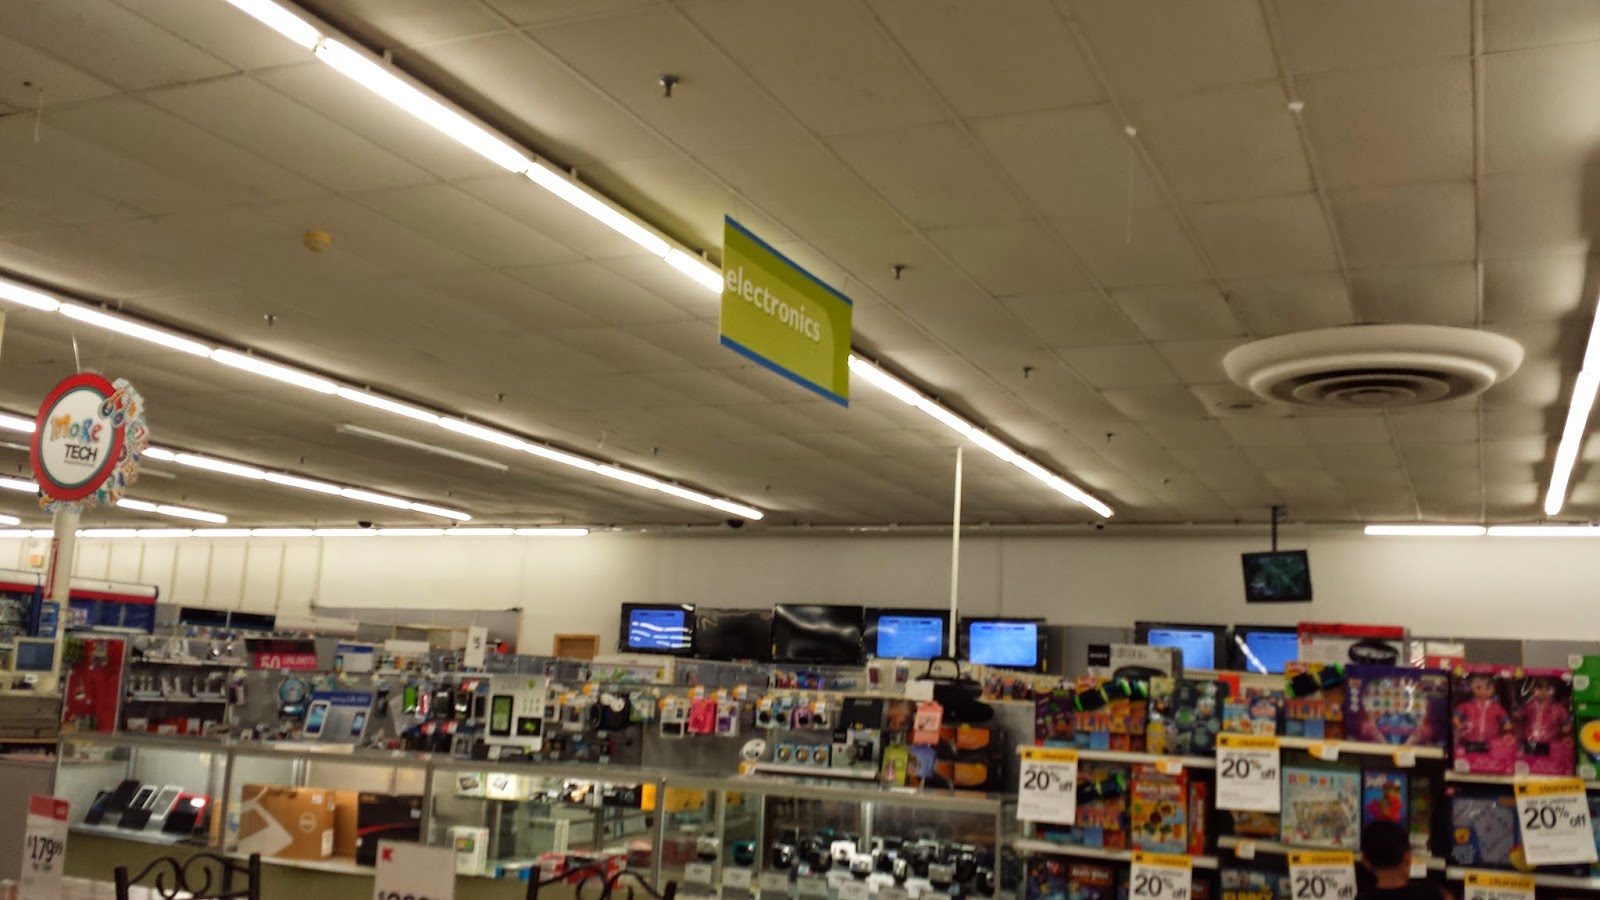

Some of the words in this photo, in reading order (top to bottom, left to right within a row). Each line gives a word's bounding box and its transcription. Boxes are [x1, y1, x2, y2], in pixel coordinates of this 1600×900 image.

[726, 266, 820, 342] electronics
[65, 444, 98, 461] TECH
[1222, 757, 1261, 779] 20%
[1024, 769, 1061, 791] 20%
[1524, 805, 1570, 830] 20%
[1569, 812, 1586, 828] off
[1135, 873, 1174, 897] 20%
[1296, 876, 1338, 898] 20%
